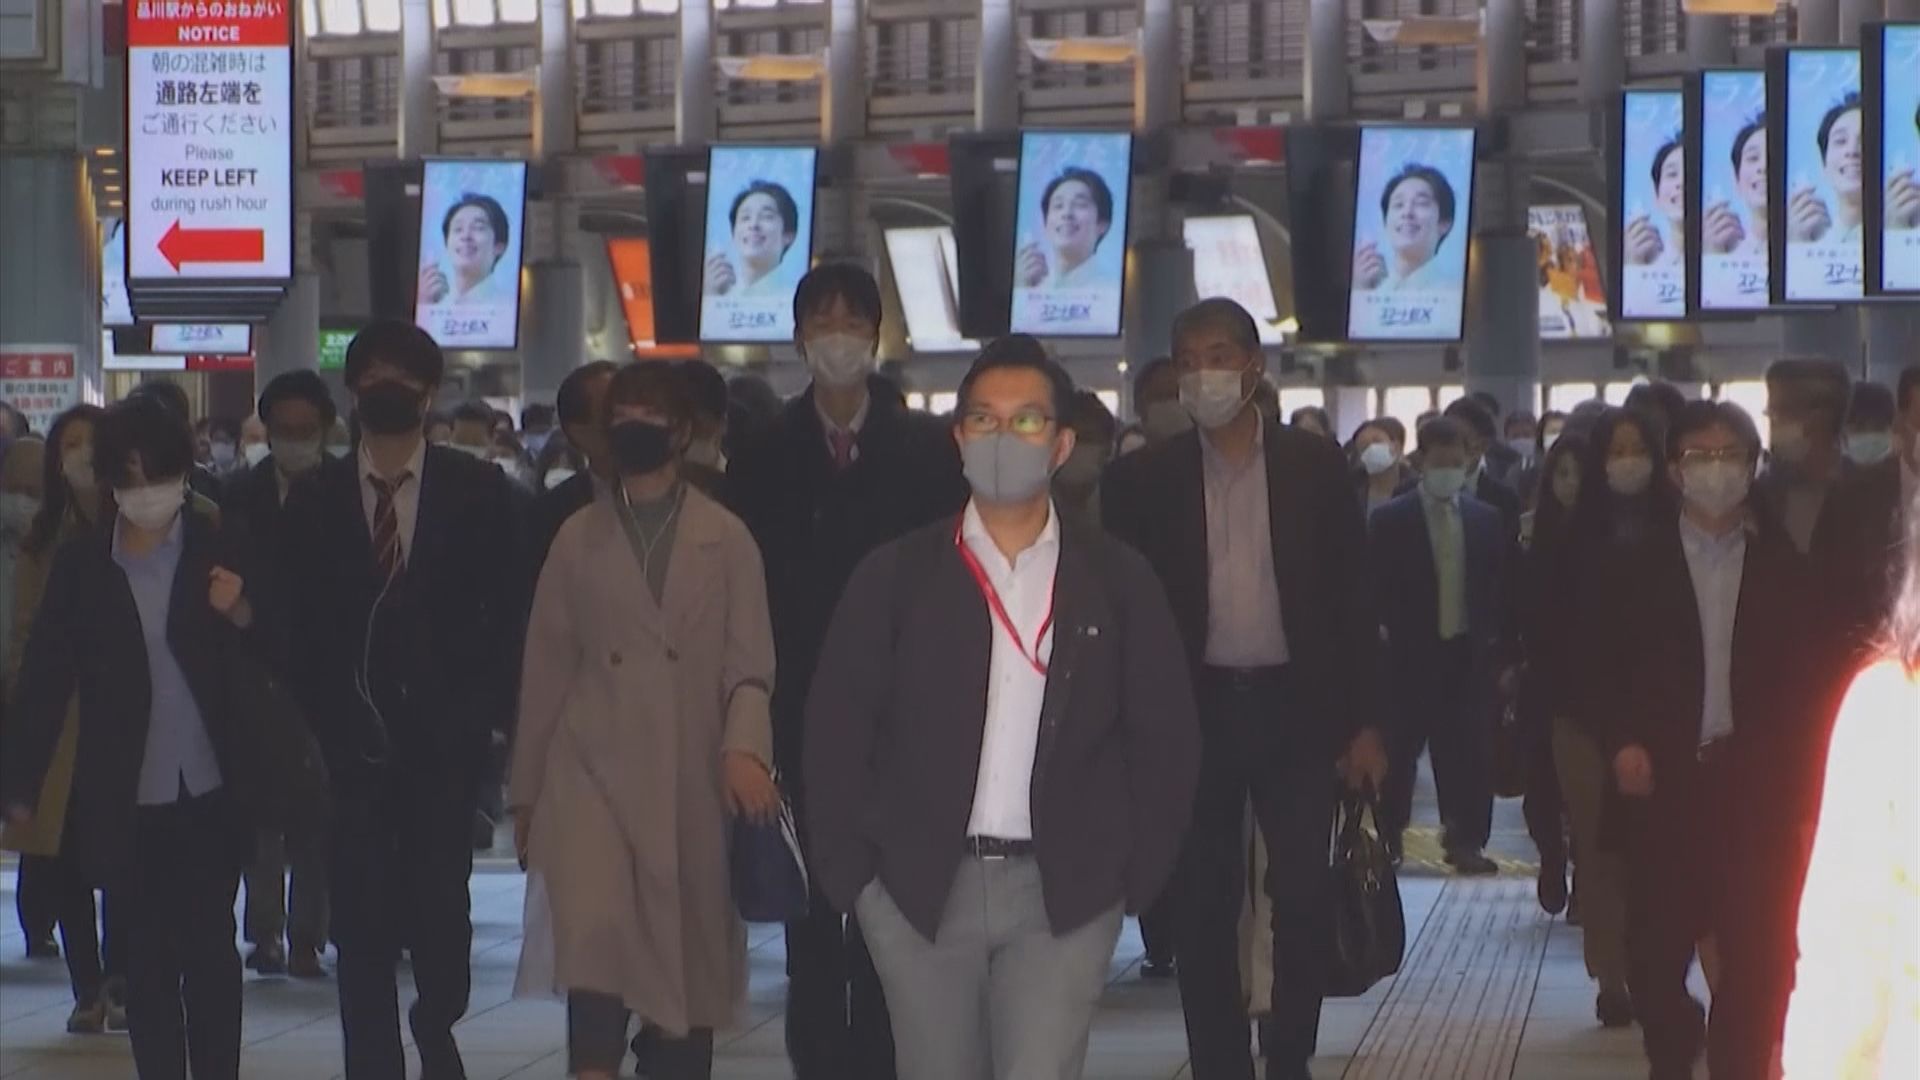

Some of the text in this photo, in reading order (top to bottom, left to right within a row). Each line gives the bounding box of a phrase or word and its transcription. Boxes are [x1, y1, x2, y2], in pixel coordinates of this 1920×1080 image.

[137, 0, 281, 19] 品川駅からのおねがい
[178, 26, 240, 41] NOTICE
[152, 51, 267, 73] 朝の混雑時は
[156, 80, 261, 105] 通路左端を
[142, 113, 277, 136] ご通行ください
[185, 144, 234, 161] Please
[162, 169, 258, 187] KEEP LEFT
[151, 197, 267, 214] during rush hour
